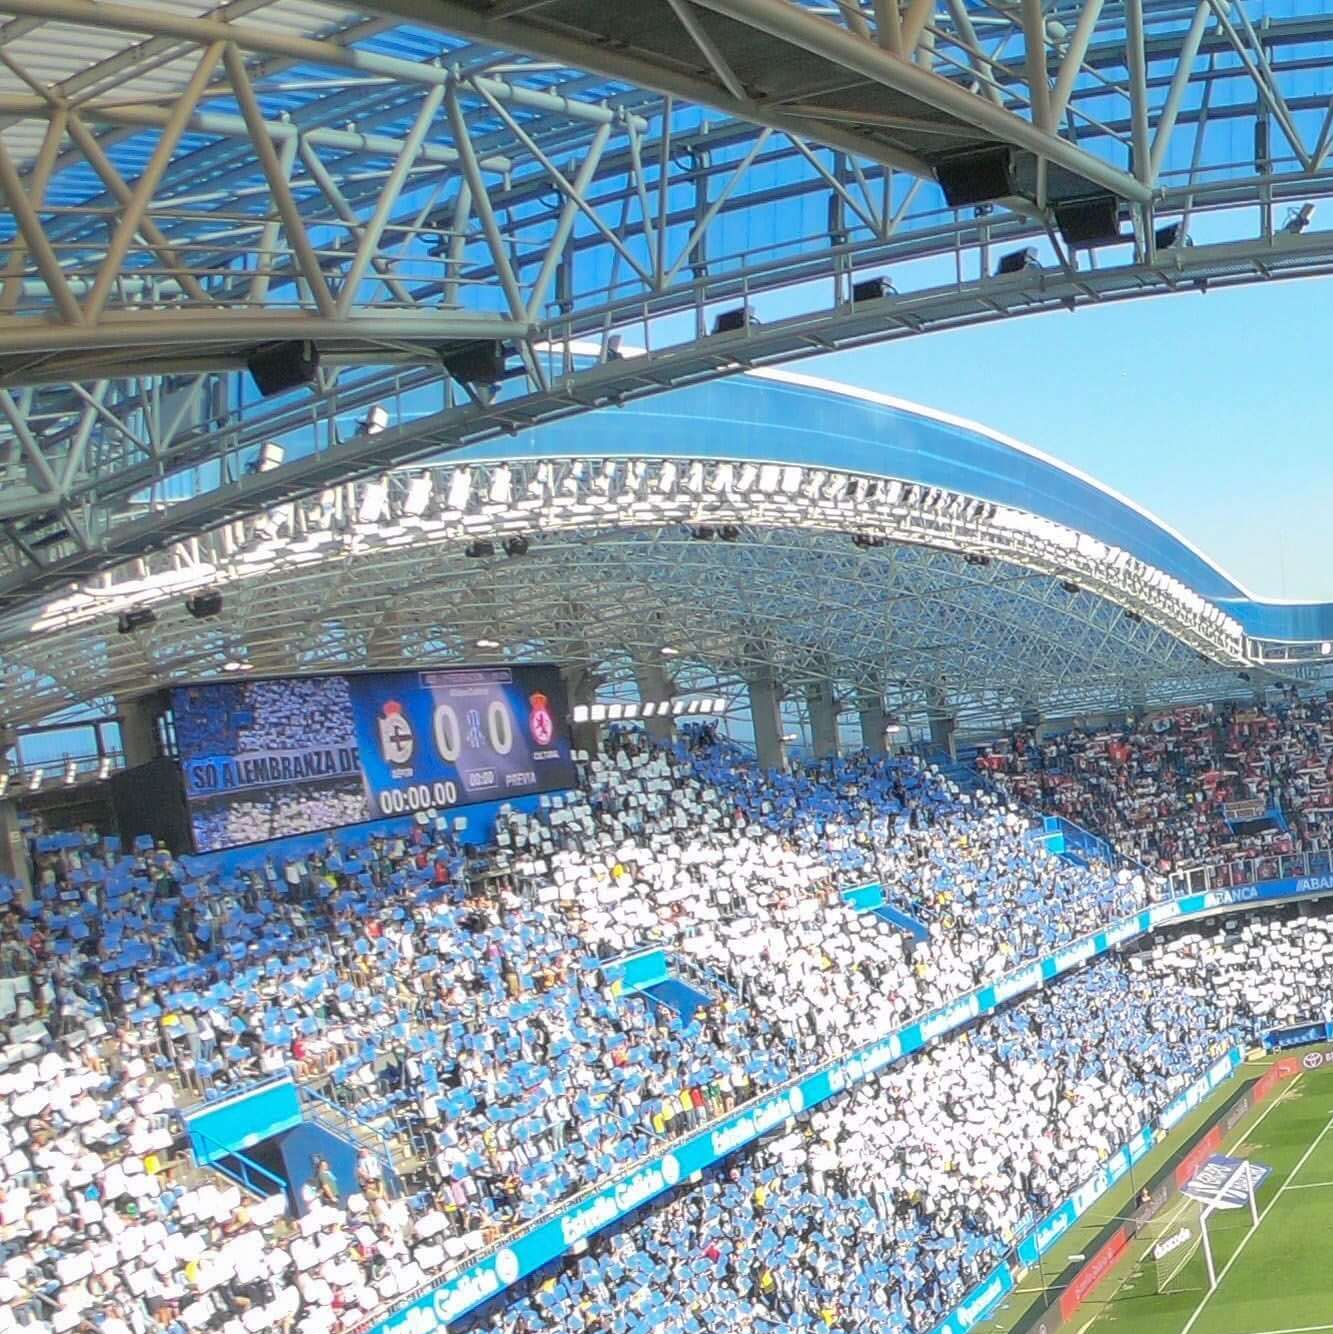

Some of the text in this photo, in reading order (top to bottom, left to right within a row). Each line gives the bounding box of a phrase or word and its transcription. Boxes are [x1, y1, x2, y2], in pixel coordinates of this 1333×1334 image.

[433, 704, 461, 762] 0
[488, 701, 512, 755] 0
[236, 750, 359, 784] LEMBRANZA DE
[380, 783, 457, 814] 00:00.00
